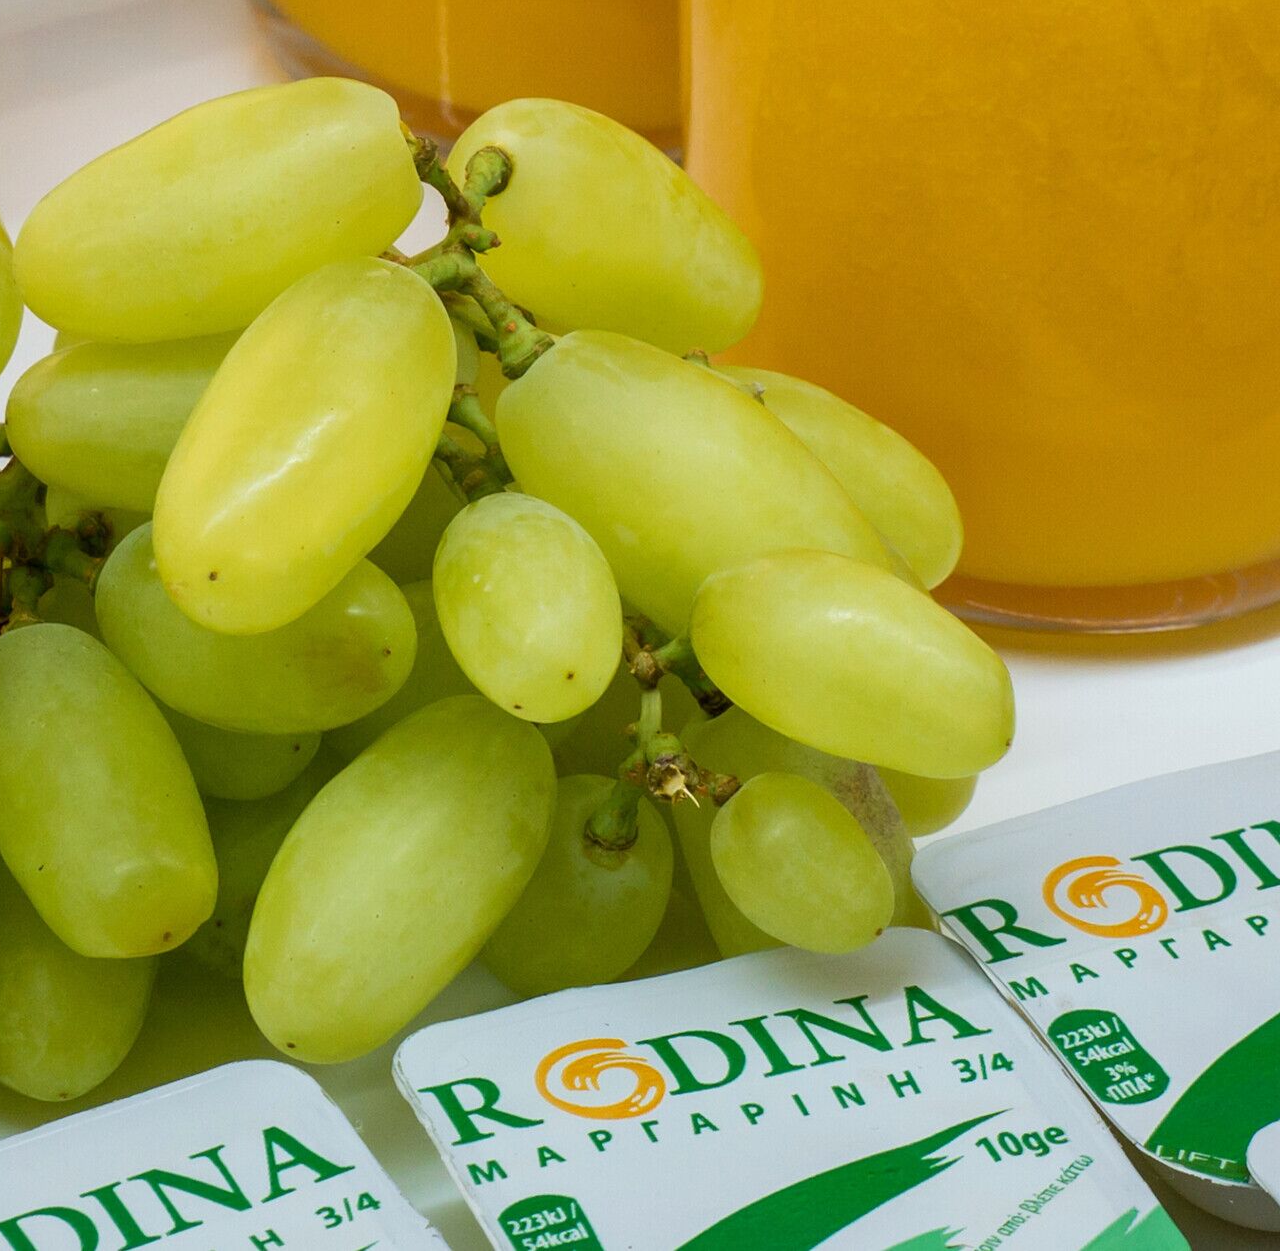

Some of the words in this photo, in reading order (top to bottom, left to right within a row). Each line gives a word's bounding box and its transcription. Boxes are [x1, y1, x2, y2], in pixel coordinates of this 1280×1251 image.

[419, 985, 992, 1147] RODINA
[1074, 1036, 1136, 1066] 54kcal
[467, 1071, 922, 1186] ΜΑΡΓΑΡΙΝΗ
[952, 1052, 1014, 1084] 3/4
[1156, 1144, 1238, 1170] LIFT
[315, 1191, 381, 1229] 3/4
[507, 1207, 568, 1235] 223kJ
